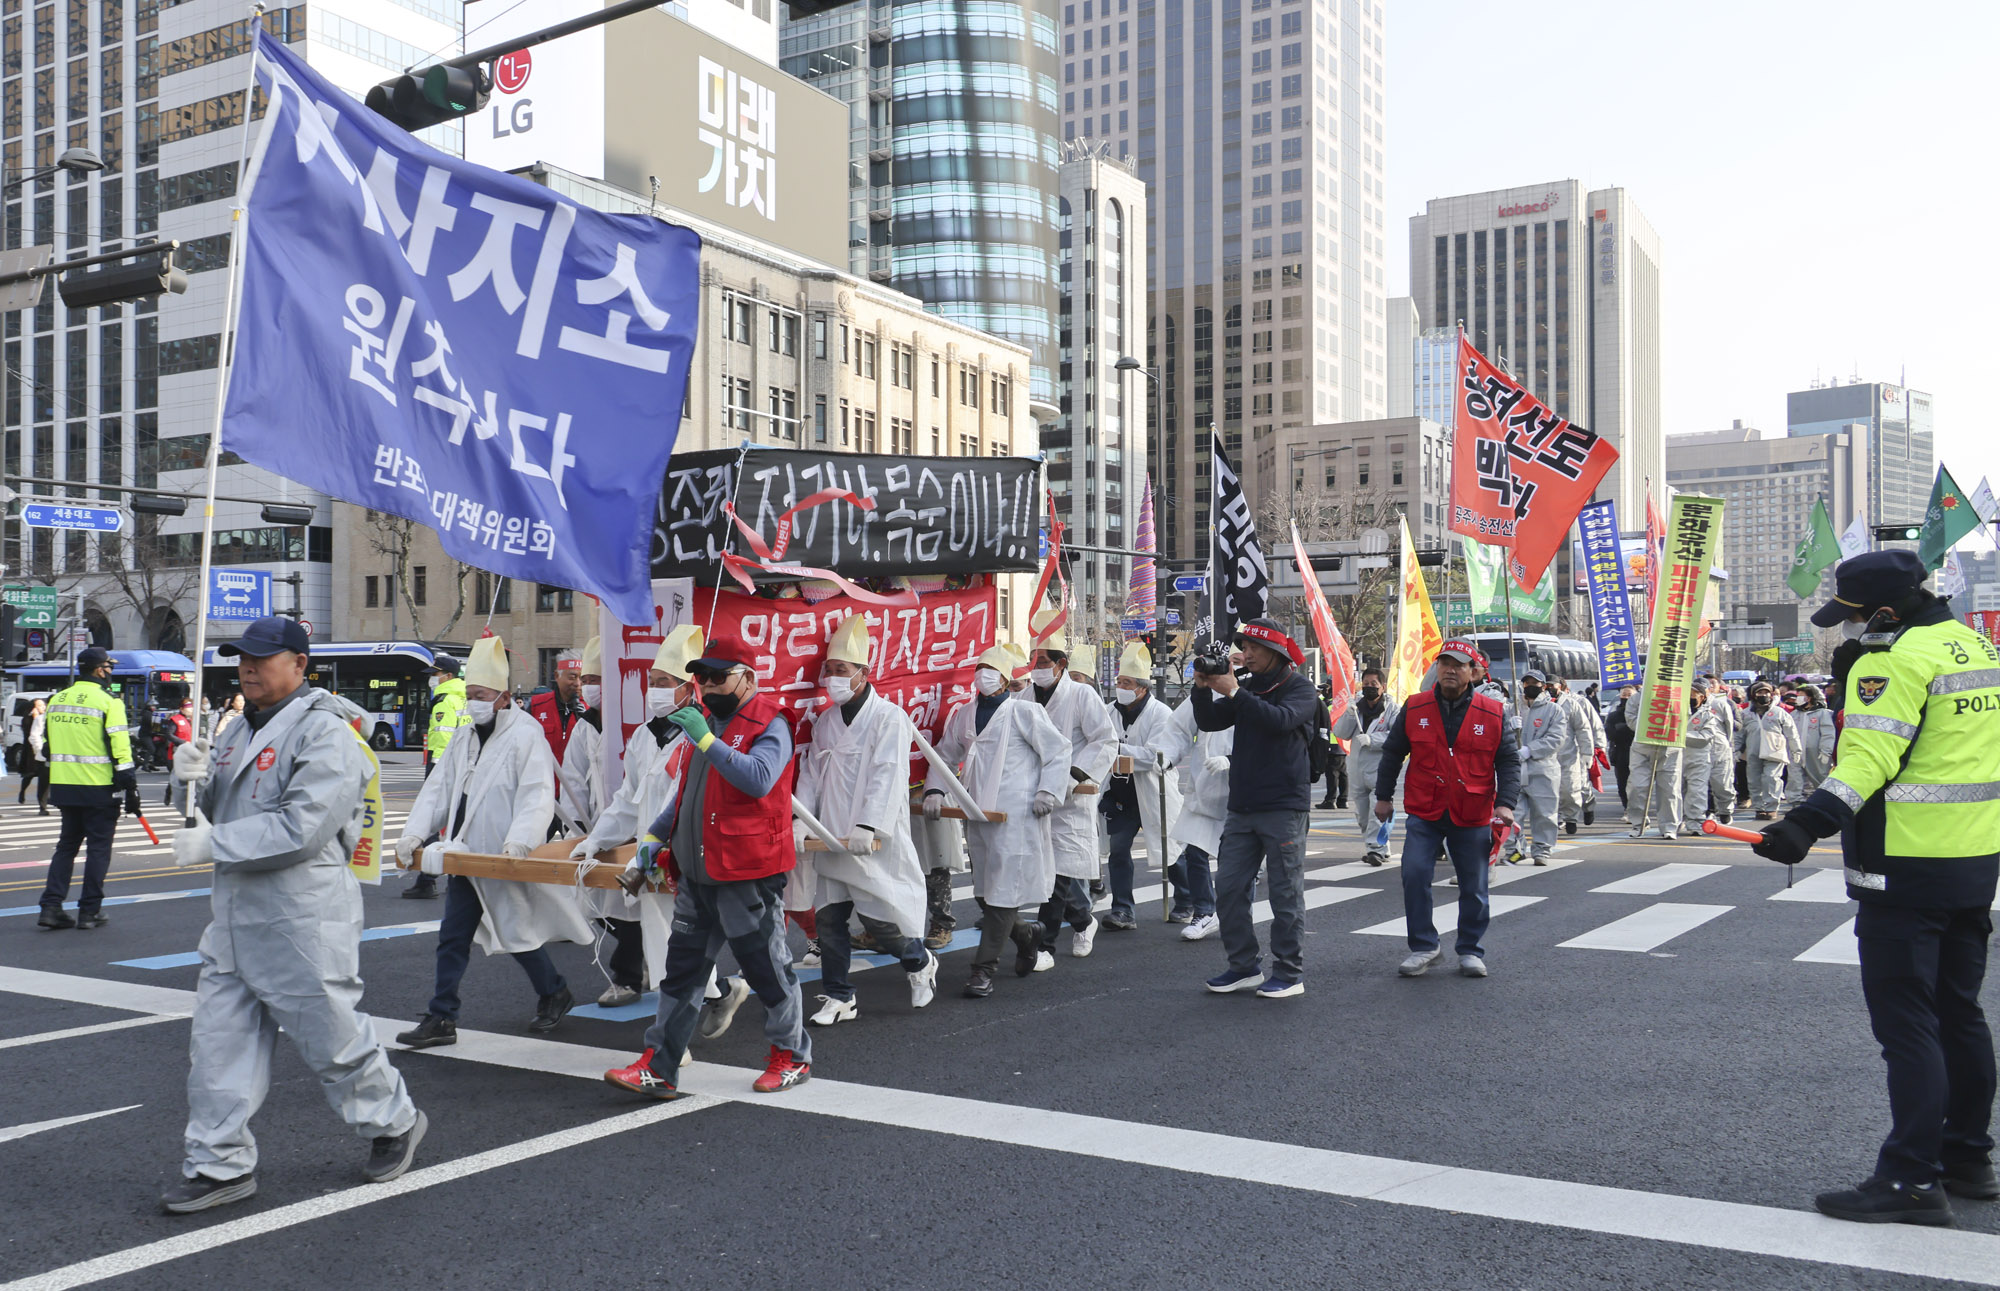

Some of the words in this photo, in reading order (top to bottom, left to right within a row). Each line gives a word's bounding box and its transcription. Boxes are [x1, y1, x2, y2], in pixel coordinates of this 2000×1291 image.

[493, 98, 533, 139] LG
[698, 55, 776, 154] 미래
[698, 127, 776, 222] 가치
[1498, 201, 1549, 218] kobaco
[1599, 222, 1616, 286] 서울신문
[27, 511, 41, 520] 162
[54, 508, 93, 520] 세종대로
[104, 516, 117, 525] 158
[50, 518, 96, 528] Sejong-daero
[431, 490, 556, 561] 대책위원회
[1673, 503, 1712, 562] 문화유산
[1666, 564, 1702, 622] 파괴하는
[1656, 626, 1690, 683] 송전탑은
[51, 715, 89, 725] POLICE
[1418, 717, 1430, 729] 투
[1473, 723, 1485, 736] 쟁
